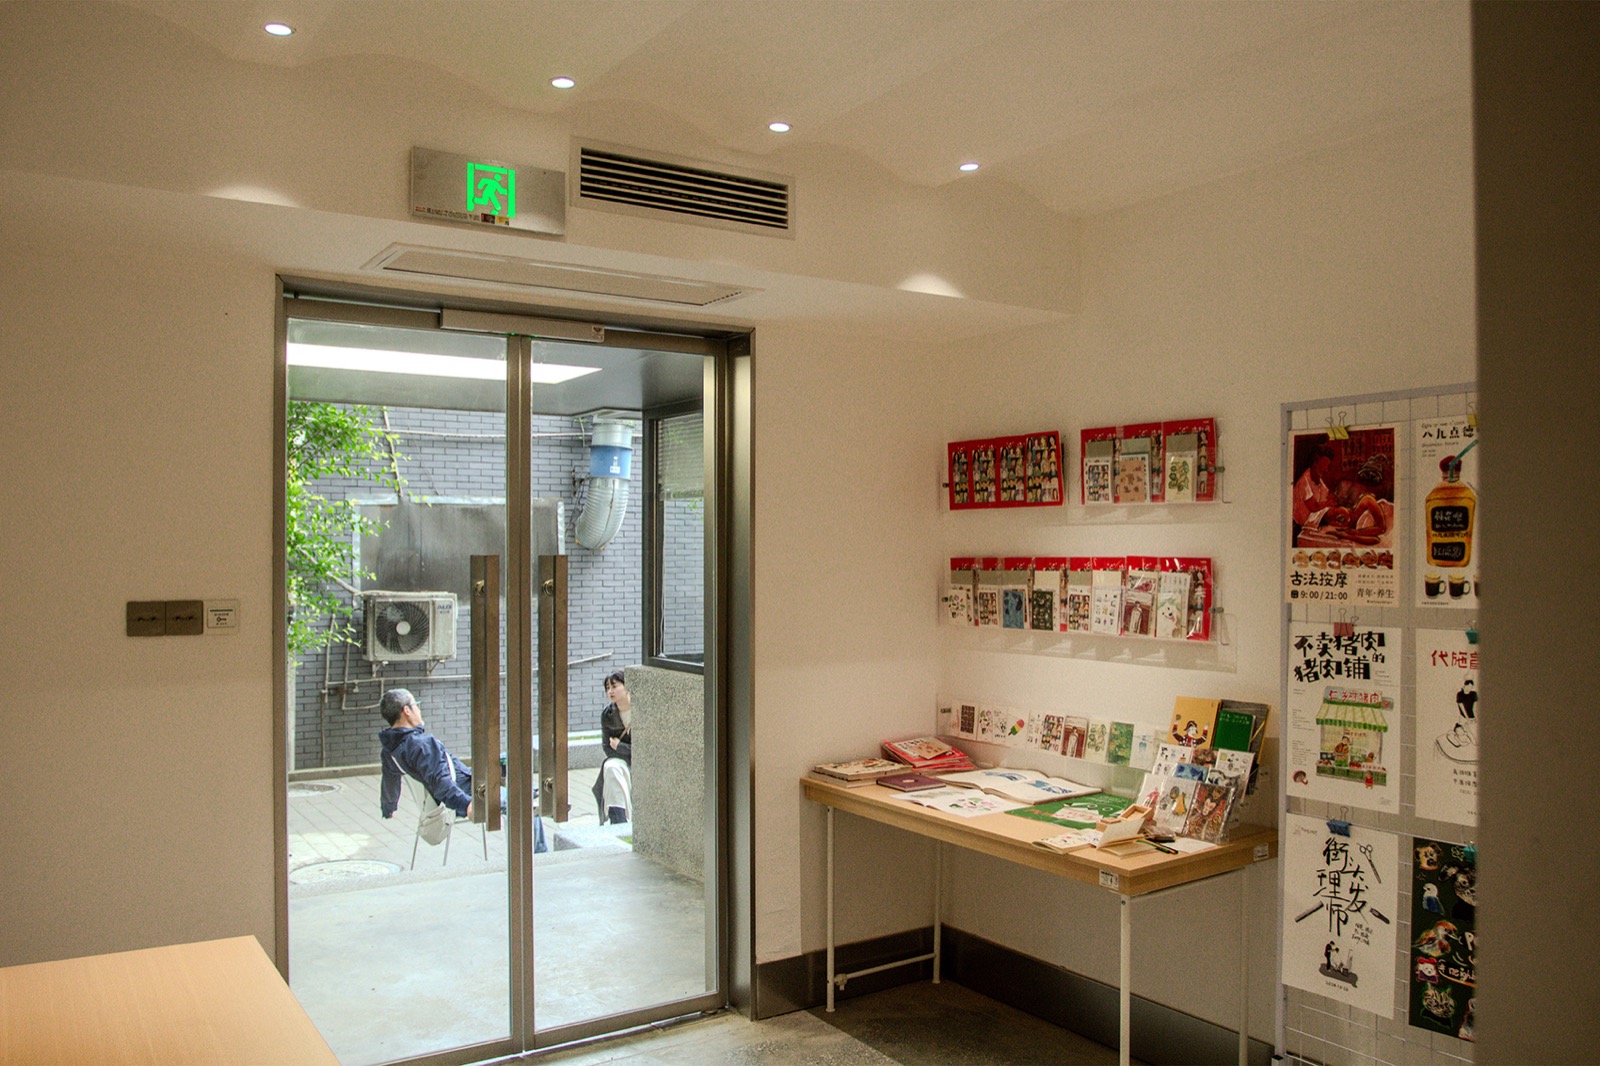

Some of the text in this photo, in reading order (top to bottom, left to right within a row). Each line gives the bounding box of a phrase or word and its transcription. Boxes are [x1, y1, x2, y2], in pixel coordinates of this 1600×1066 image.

[1290, 570, 1348, 588] 古法按摩
[1294, 655, 1371, 683] 猪肉铺
